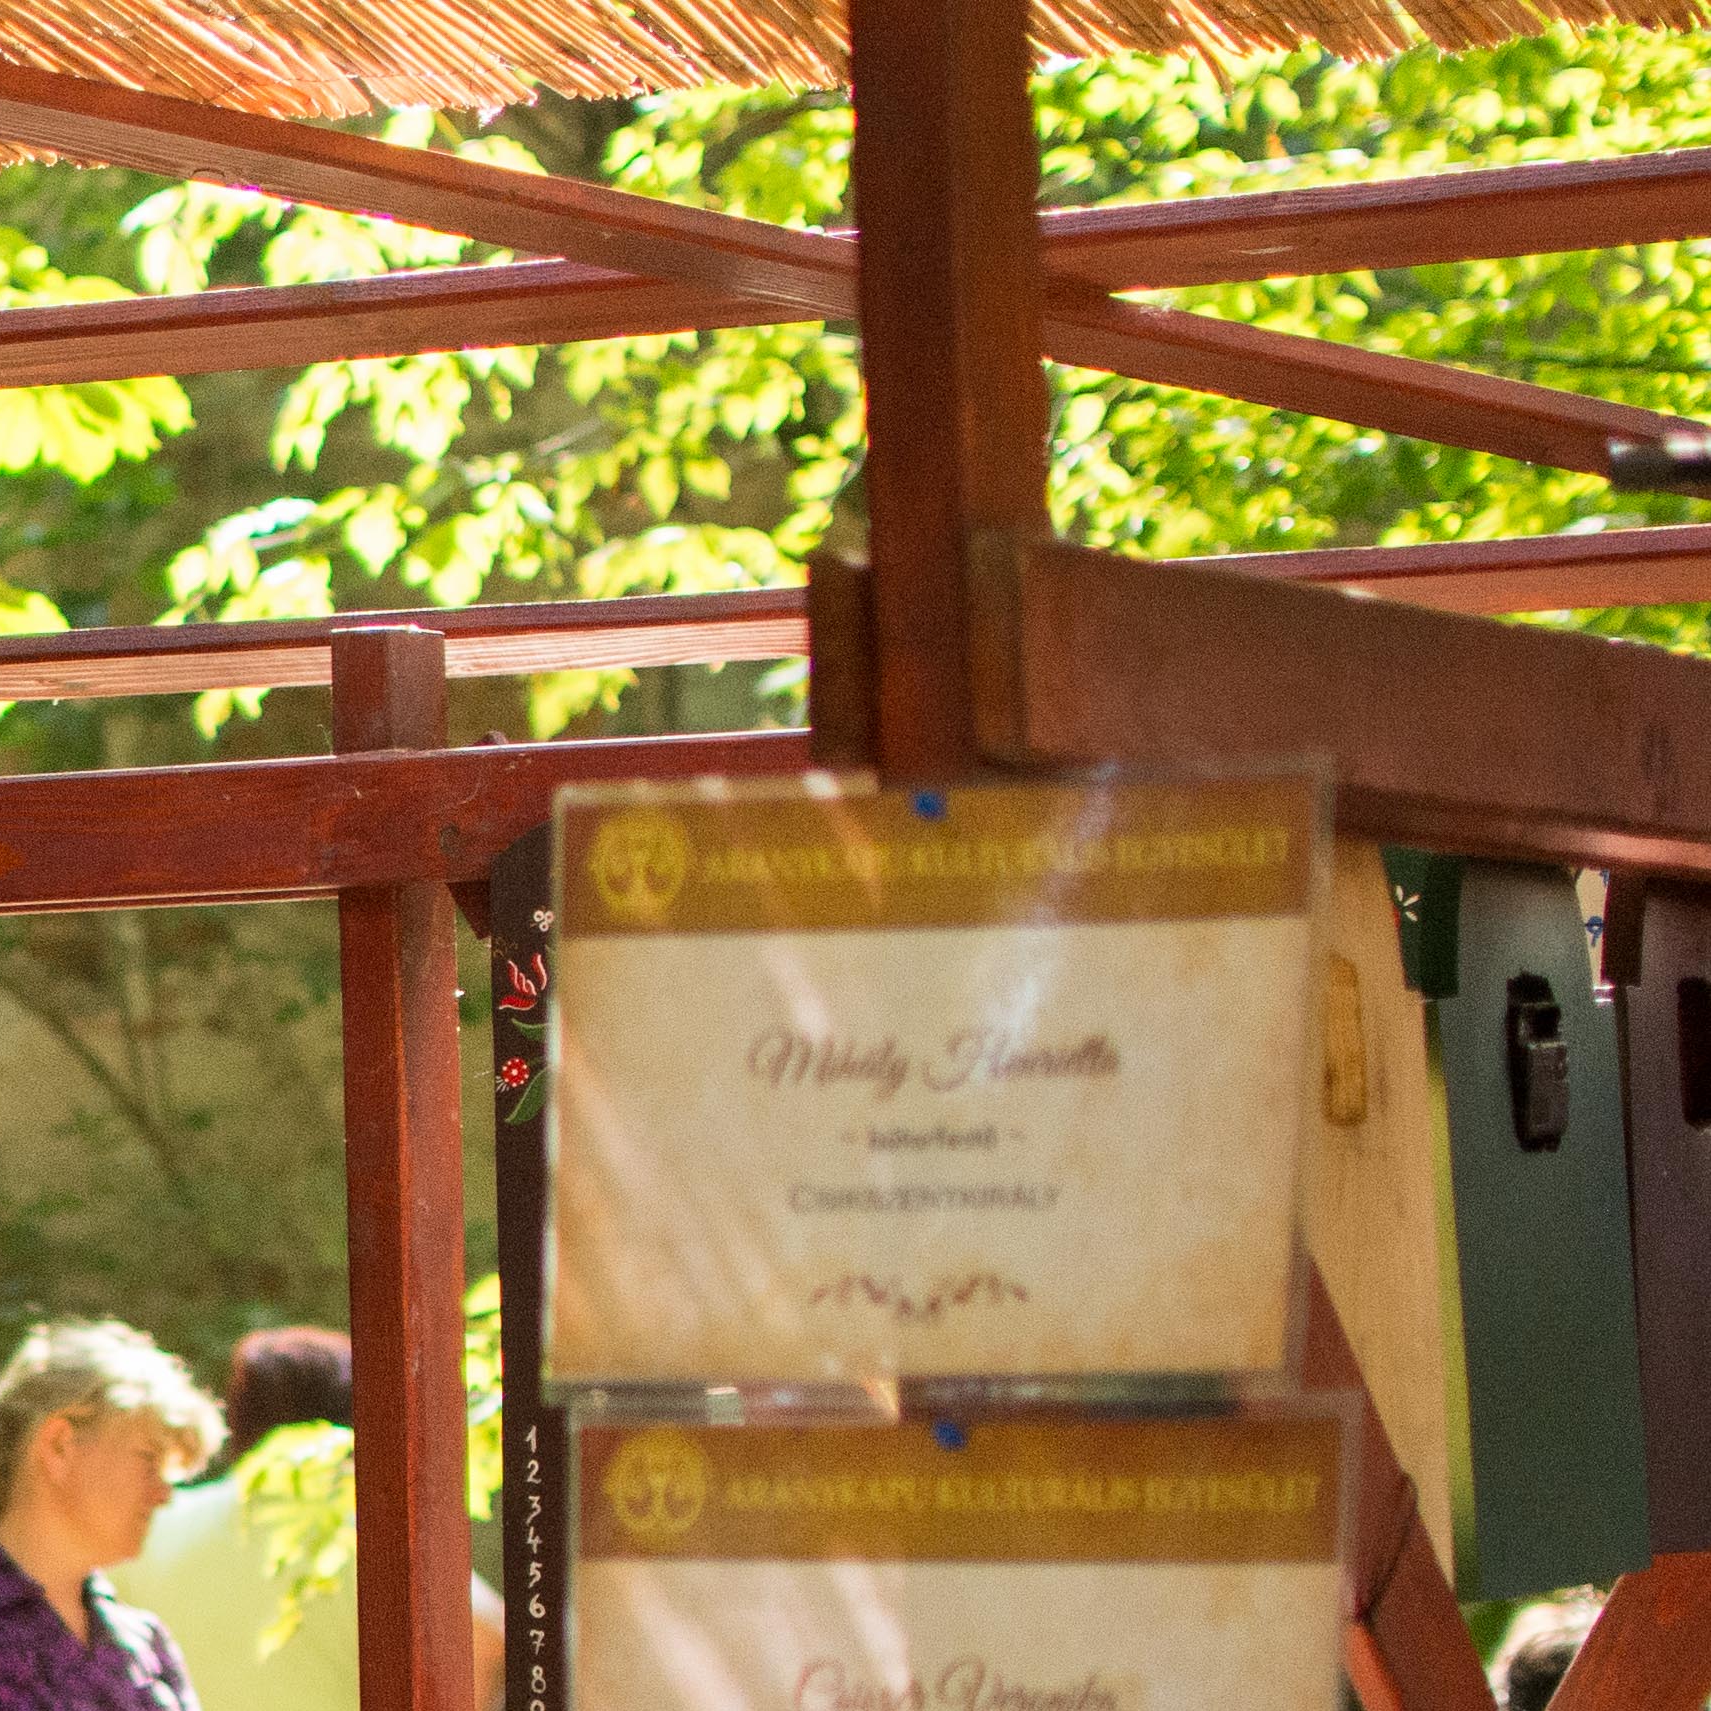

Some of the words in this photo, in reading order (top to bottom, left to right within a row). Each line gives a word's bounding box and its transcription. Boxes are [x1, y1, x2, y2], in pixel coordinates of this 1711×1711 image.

[525, 1424, 537, 1453] 1
[527, 1459, 542, 1484] 2
[527, 1495, 541, 1524] 3
[527, 1526, 543, 1554] 4
[528, 1561, 543, 1588] 5
[529, 1593, 546, 1619] 6
[529, 1629, 545, 1656] 7
[531, 1665, 547, 1694] 8
